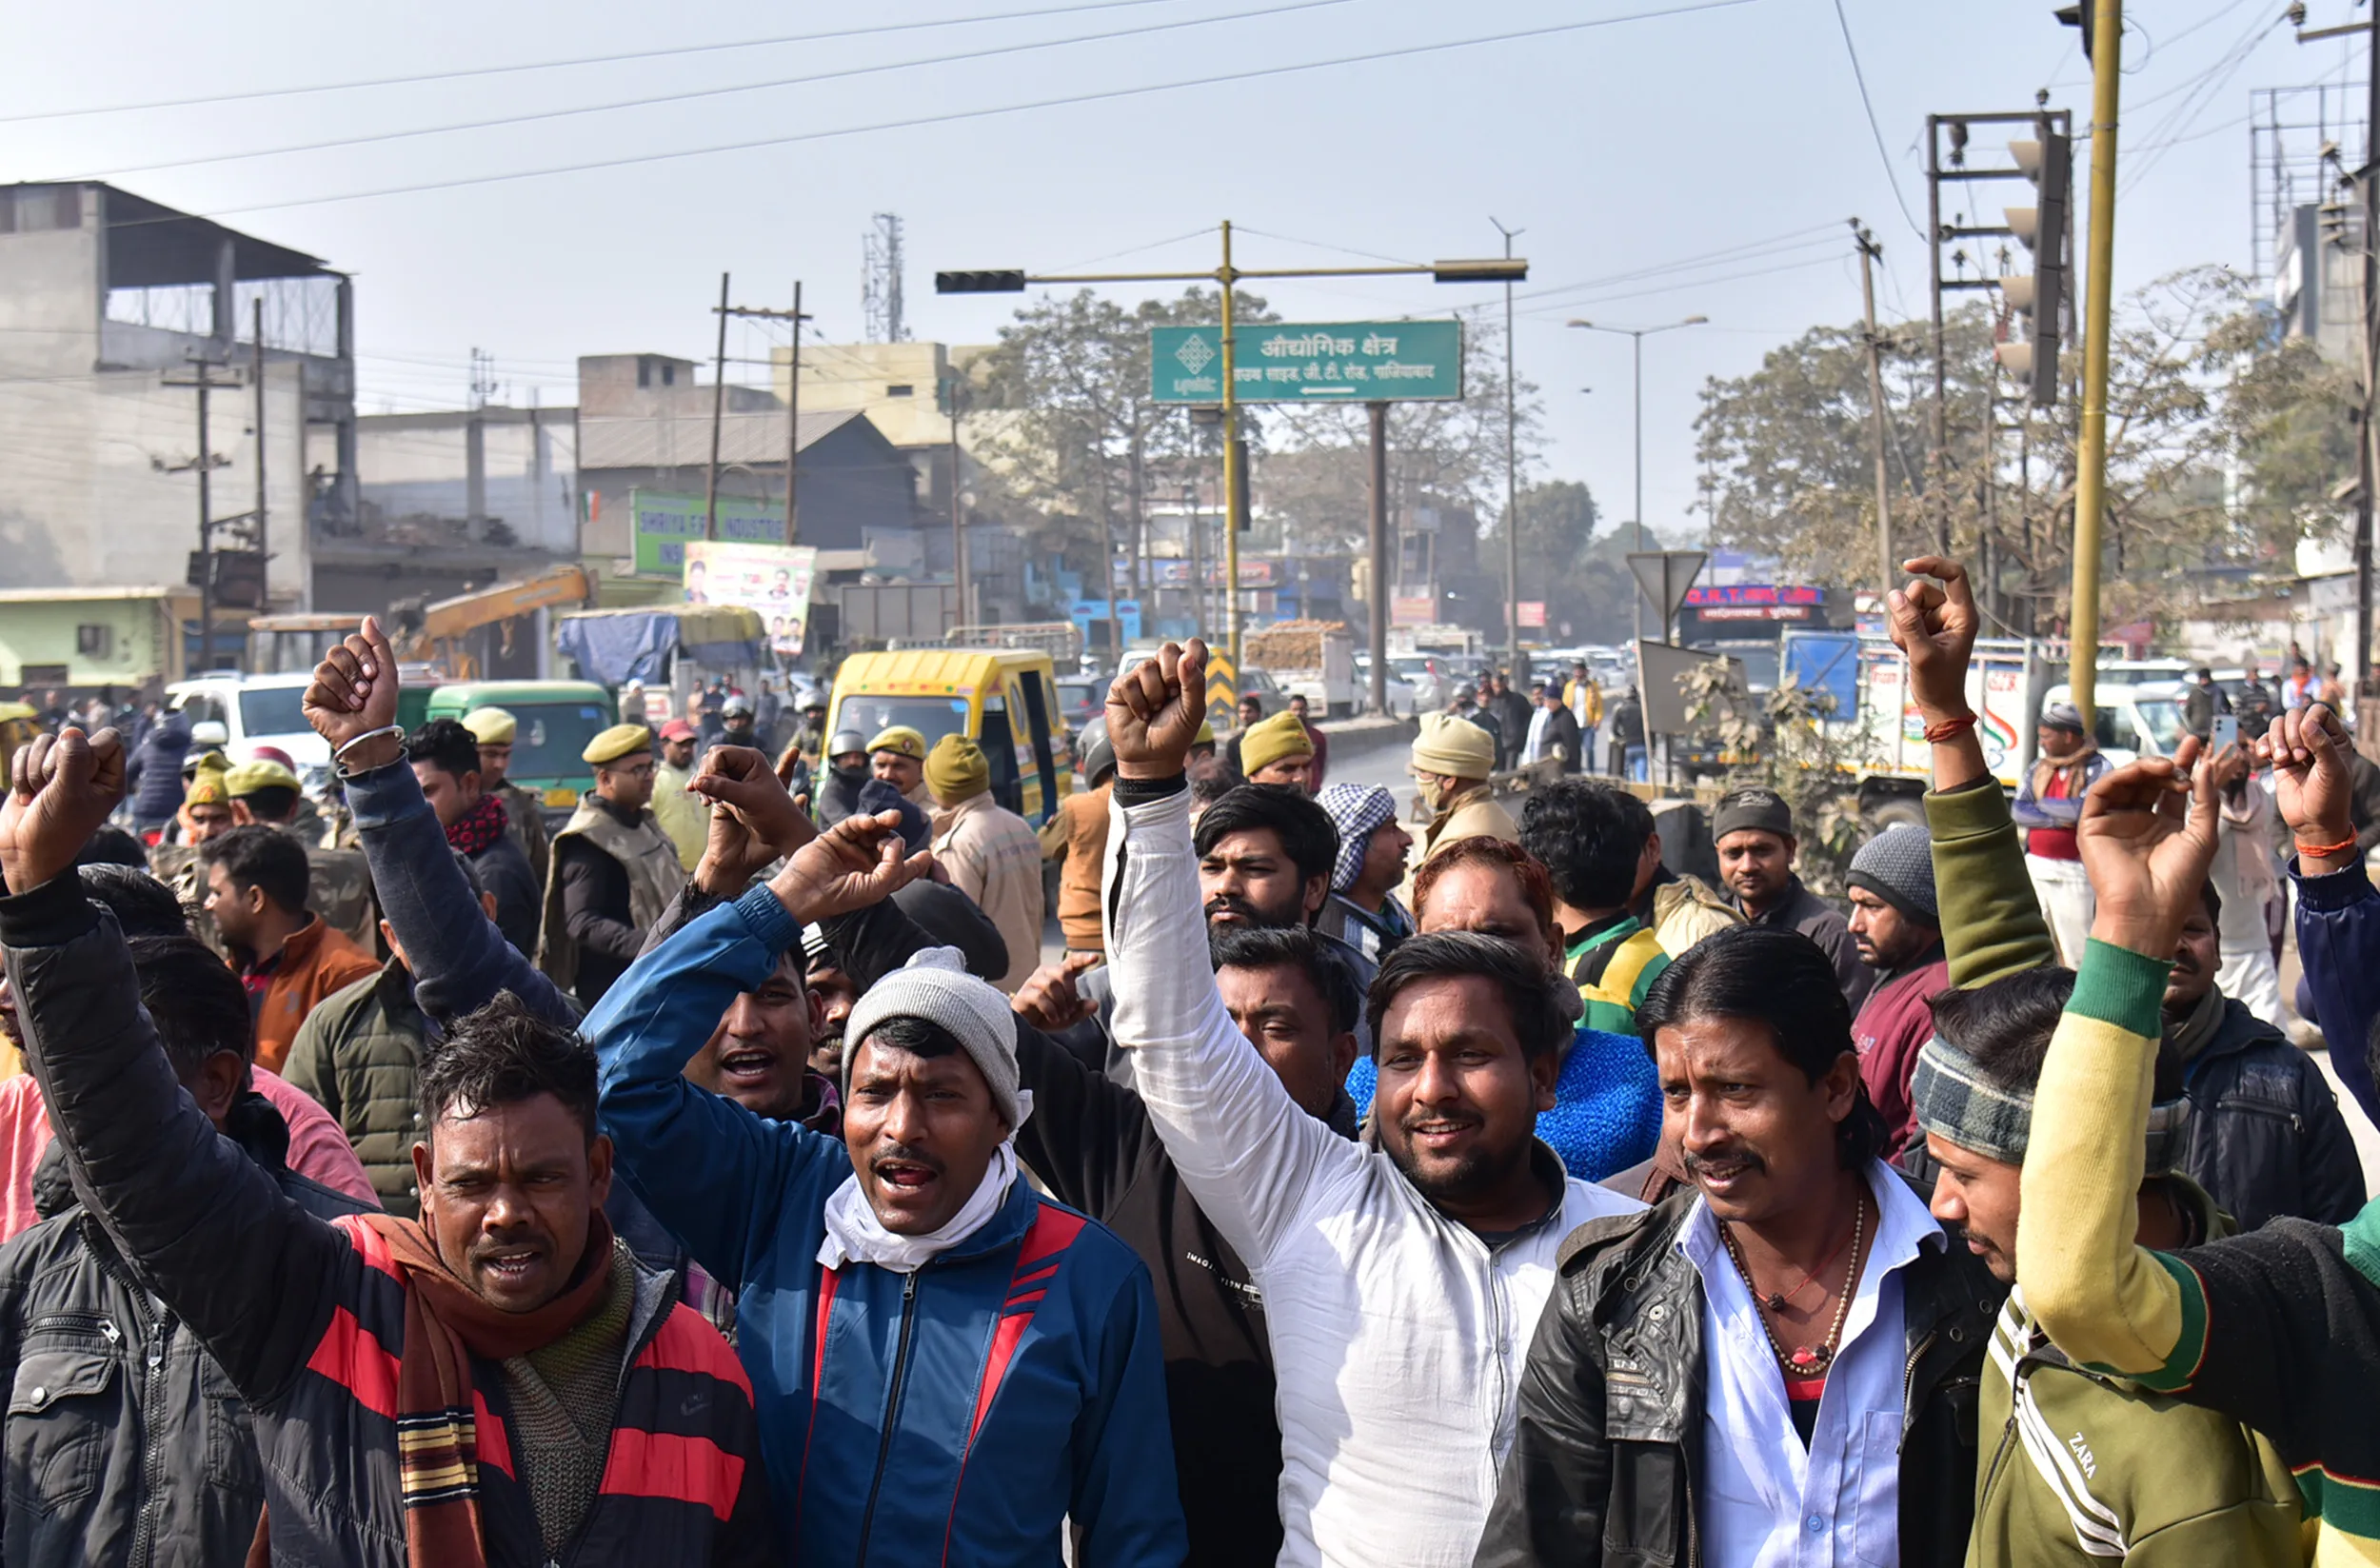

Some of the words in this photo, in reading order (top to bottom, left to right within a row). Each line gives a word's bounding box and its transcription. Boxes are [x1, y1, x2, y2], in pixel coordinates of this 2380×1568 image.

[1260, 332, 1356, 358] औद्योगिक
[1361, 332, 1398, 356] क्षेत्र
[2069, 1431, 2096, 1480] ZARA
